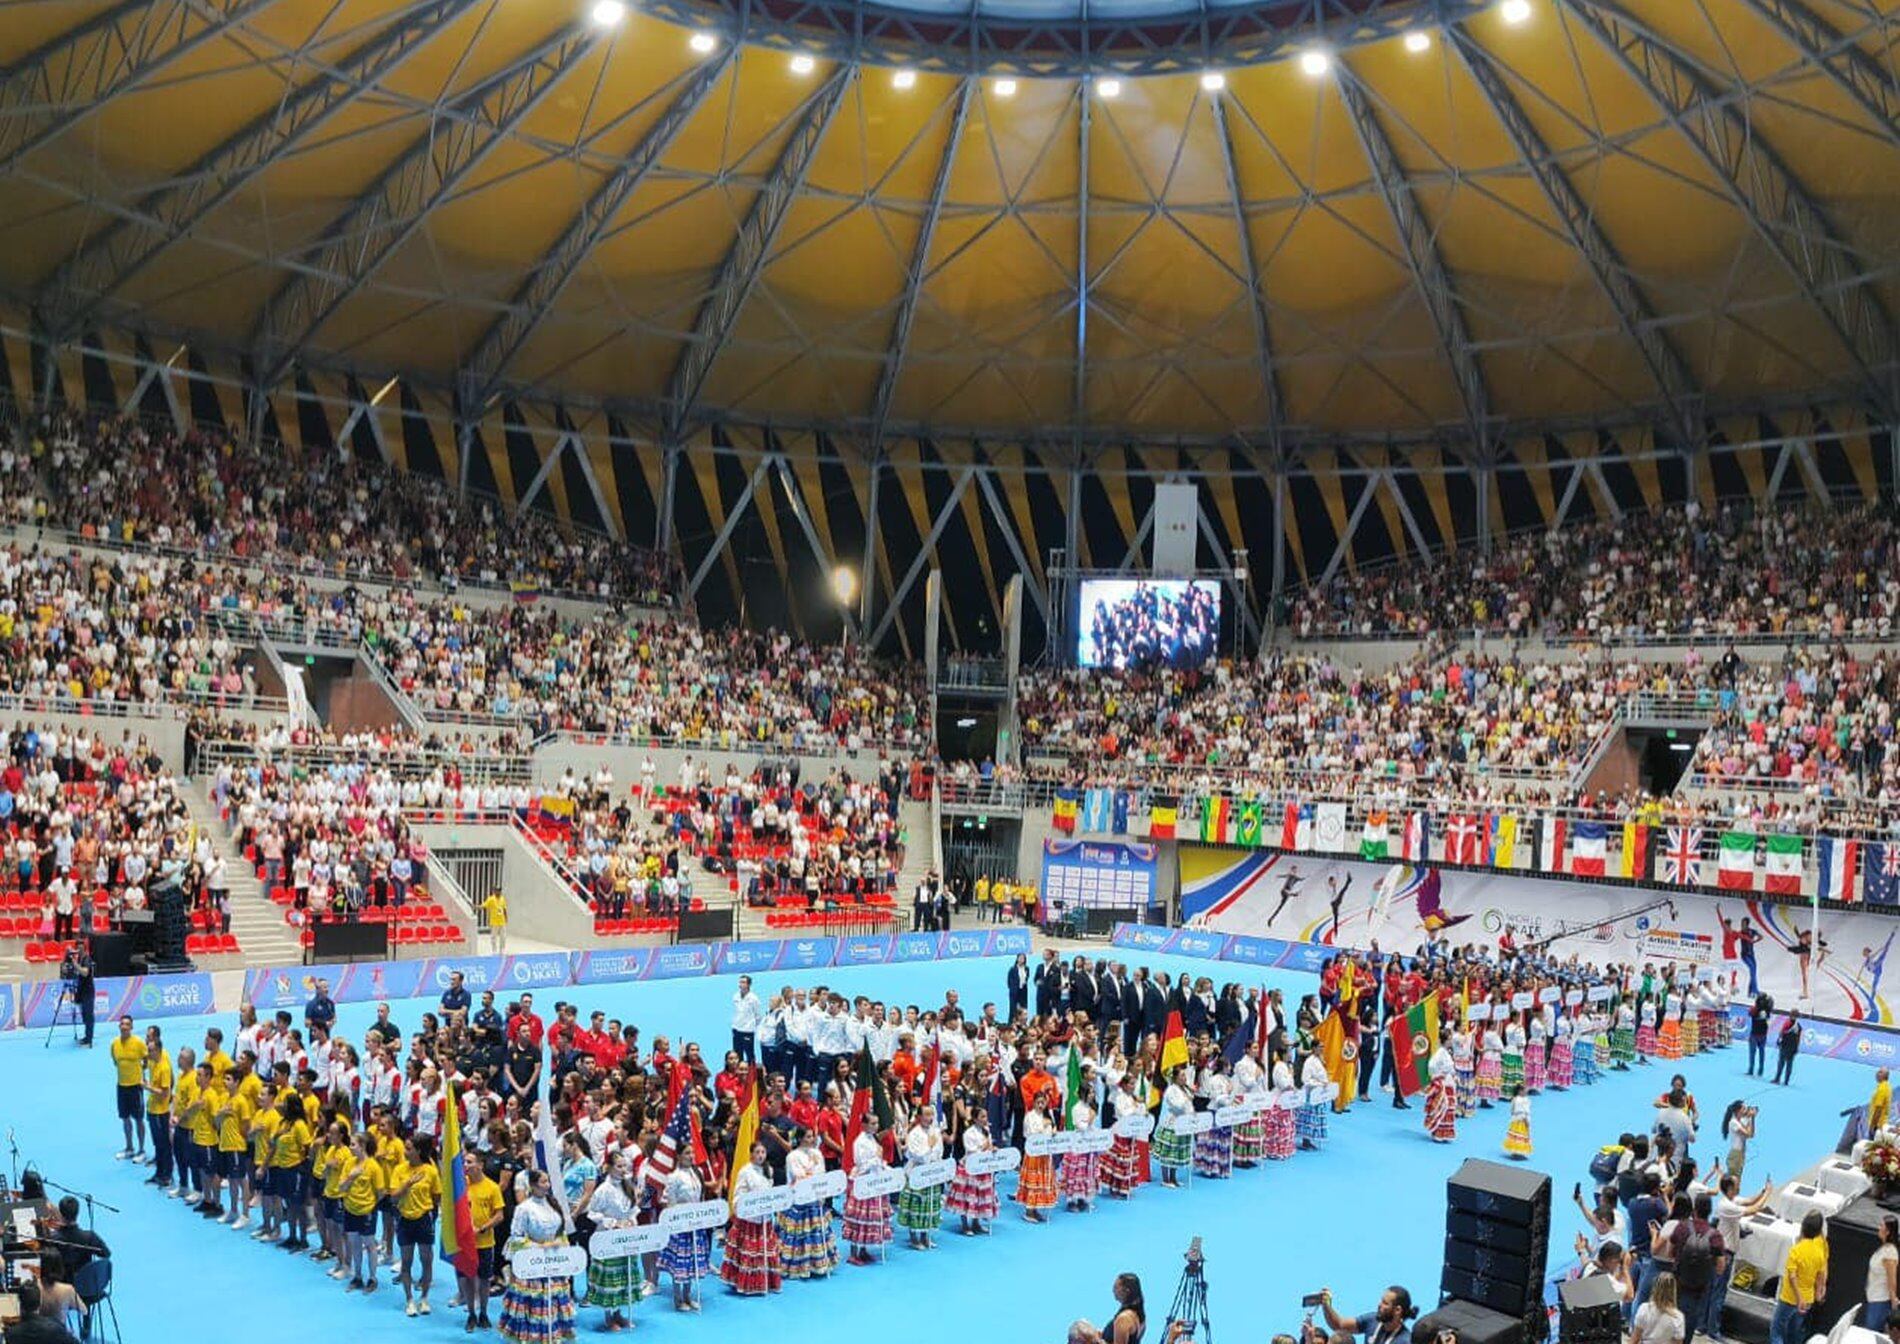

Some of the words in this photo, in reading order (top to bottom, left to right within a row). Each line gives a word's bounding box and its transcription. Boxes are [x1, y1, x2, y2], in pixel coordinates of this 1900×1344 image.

[162, 983, 199, 996] WORLD
[163, 993, 200, 1006] SKATE
[529, 1255, 569, 1266] COLOMBIA
